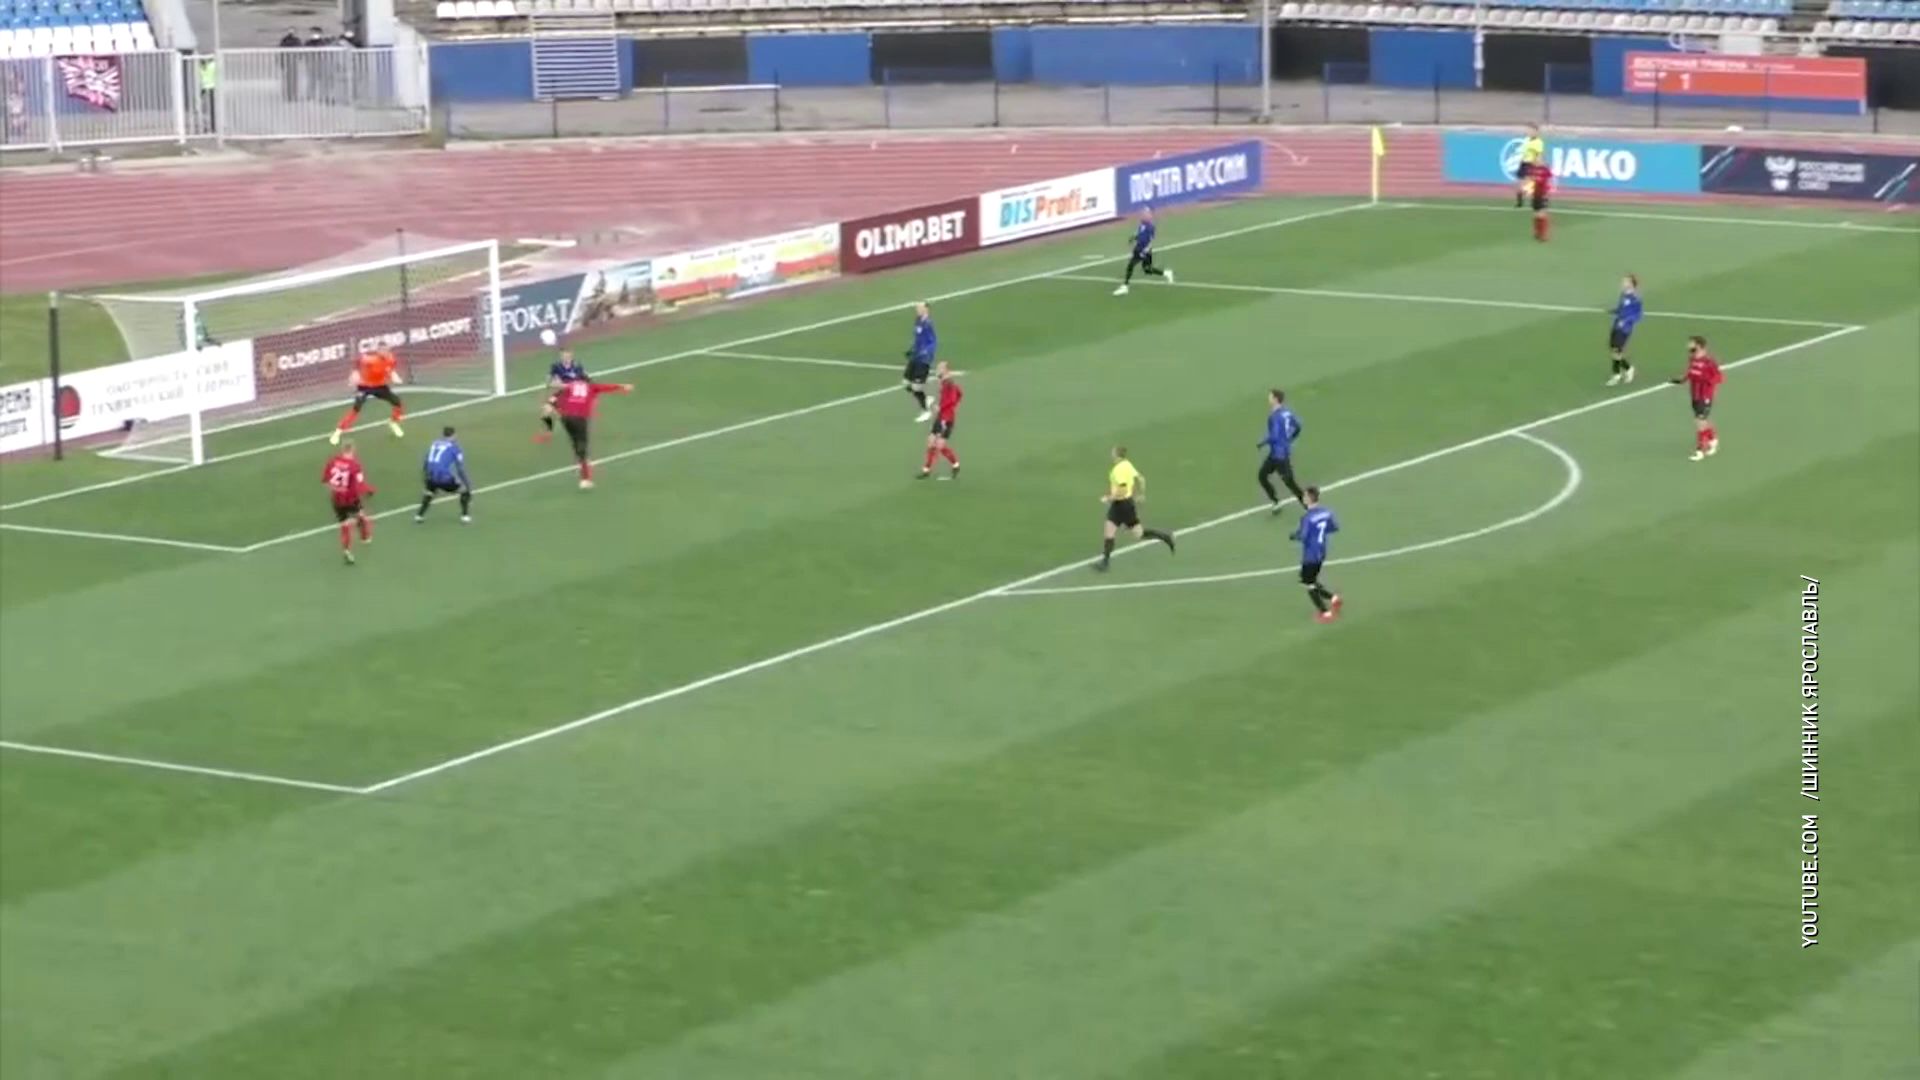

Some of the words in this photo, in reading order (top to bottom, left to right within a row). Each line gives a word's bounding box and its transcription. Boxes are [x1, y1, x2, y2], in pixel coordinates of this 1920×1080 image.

[1680, 73, 1691, 90] 1
[1129, 166, 1183, 203] ПОЧТА
[1185, 153, 1247, 191] РОССИИ
[855, 210, 967, 257] OLIMP.BET
[428, 444, 445, 463] 17
[1316, 520, 1327, 543] 7
